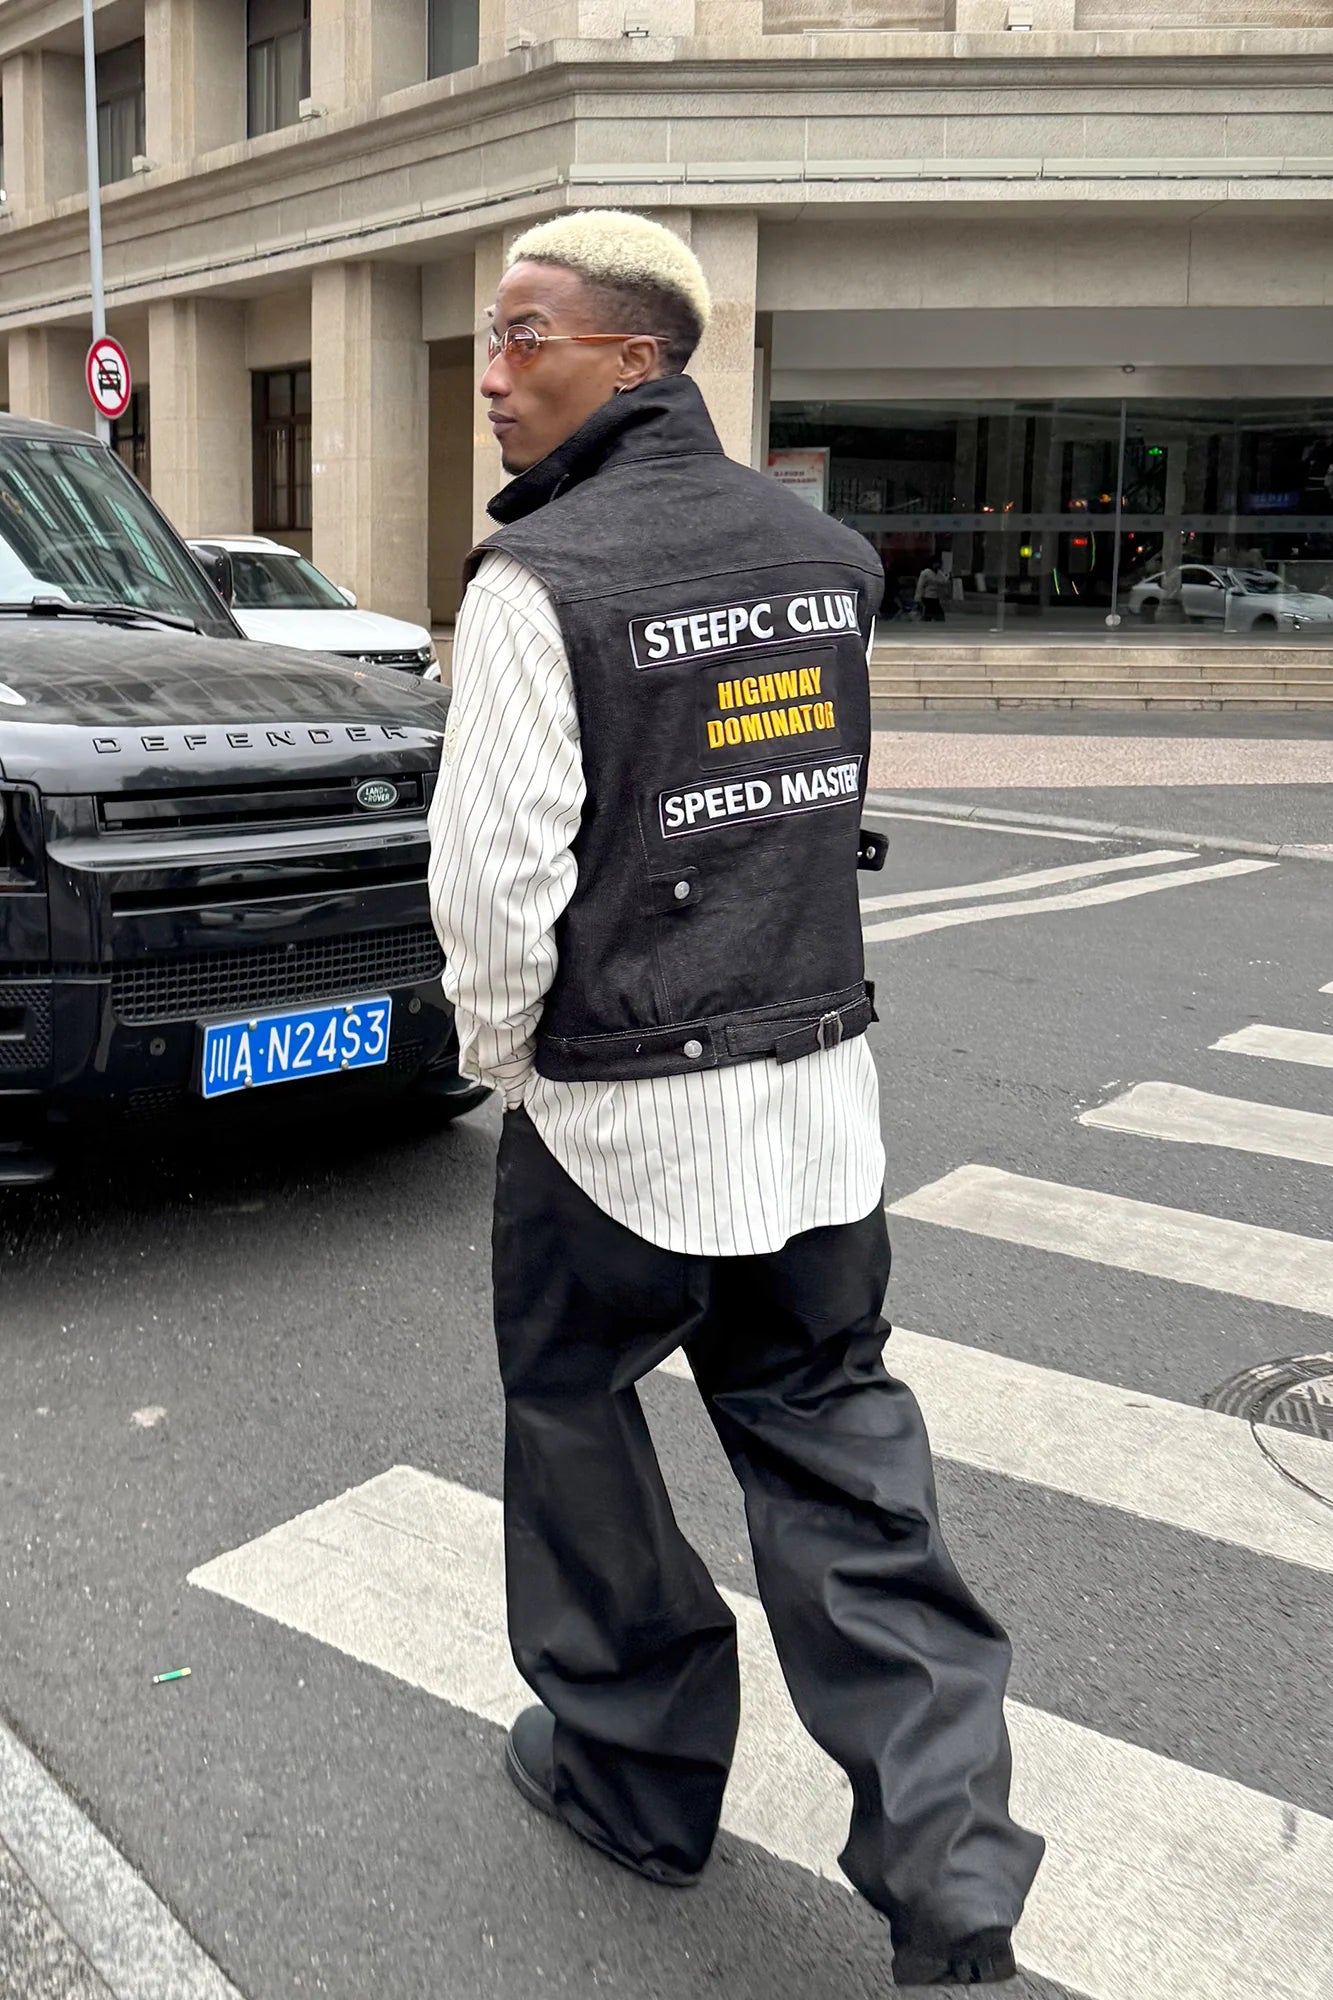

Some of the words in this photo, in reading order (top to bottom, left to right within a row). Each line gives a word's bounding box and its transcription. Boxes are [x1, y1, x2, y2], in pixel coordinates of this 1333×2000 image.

[644, 603, 774, 659] STEEPC
[787, 595, 857, 633] CLUB
[717, 667, 822, 710] HIGHWAY
[92, 725, 408, 754] DEFENDER
[707, 701, 835, 749] DOMINATOR
[664, 780, 772, 828] SPEED
[781, 763, 858, 805] MASTER
